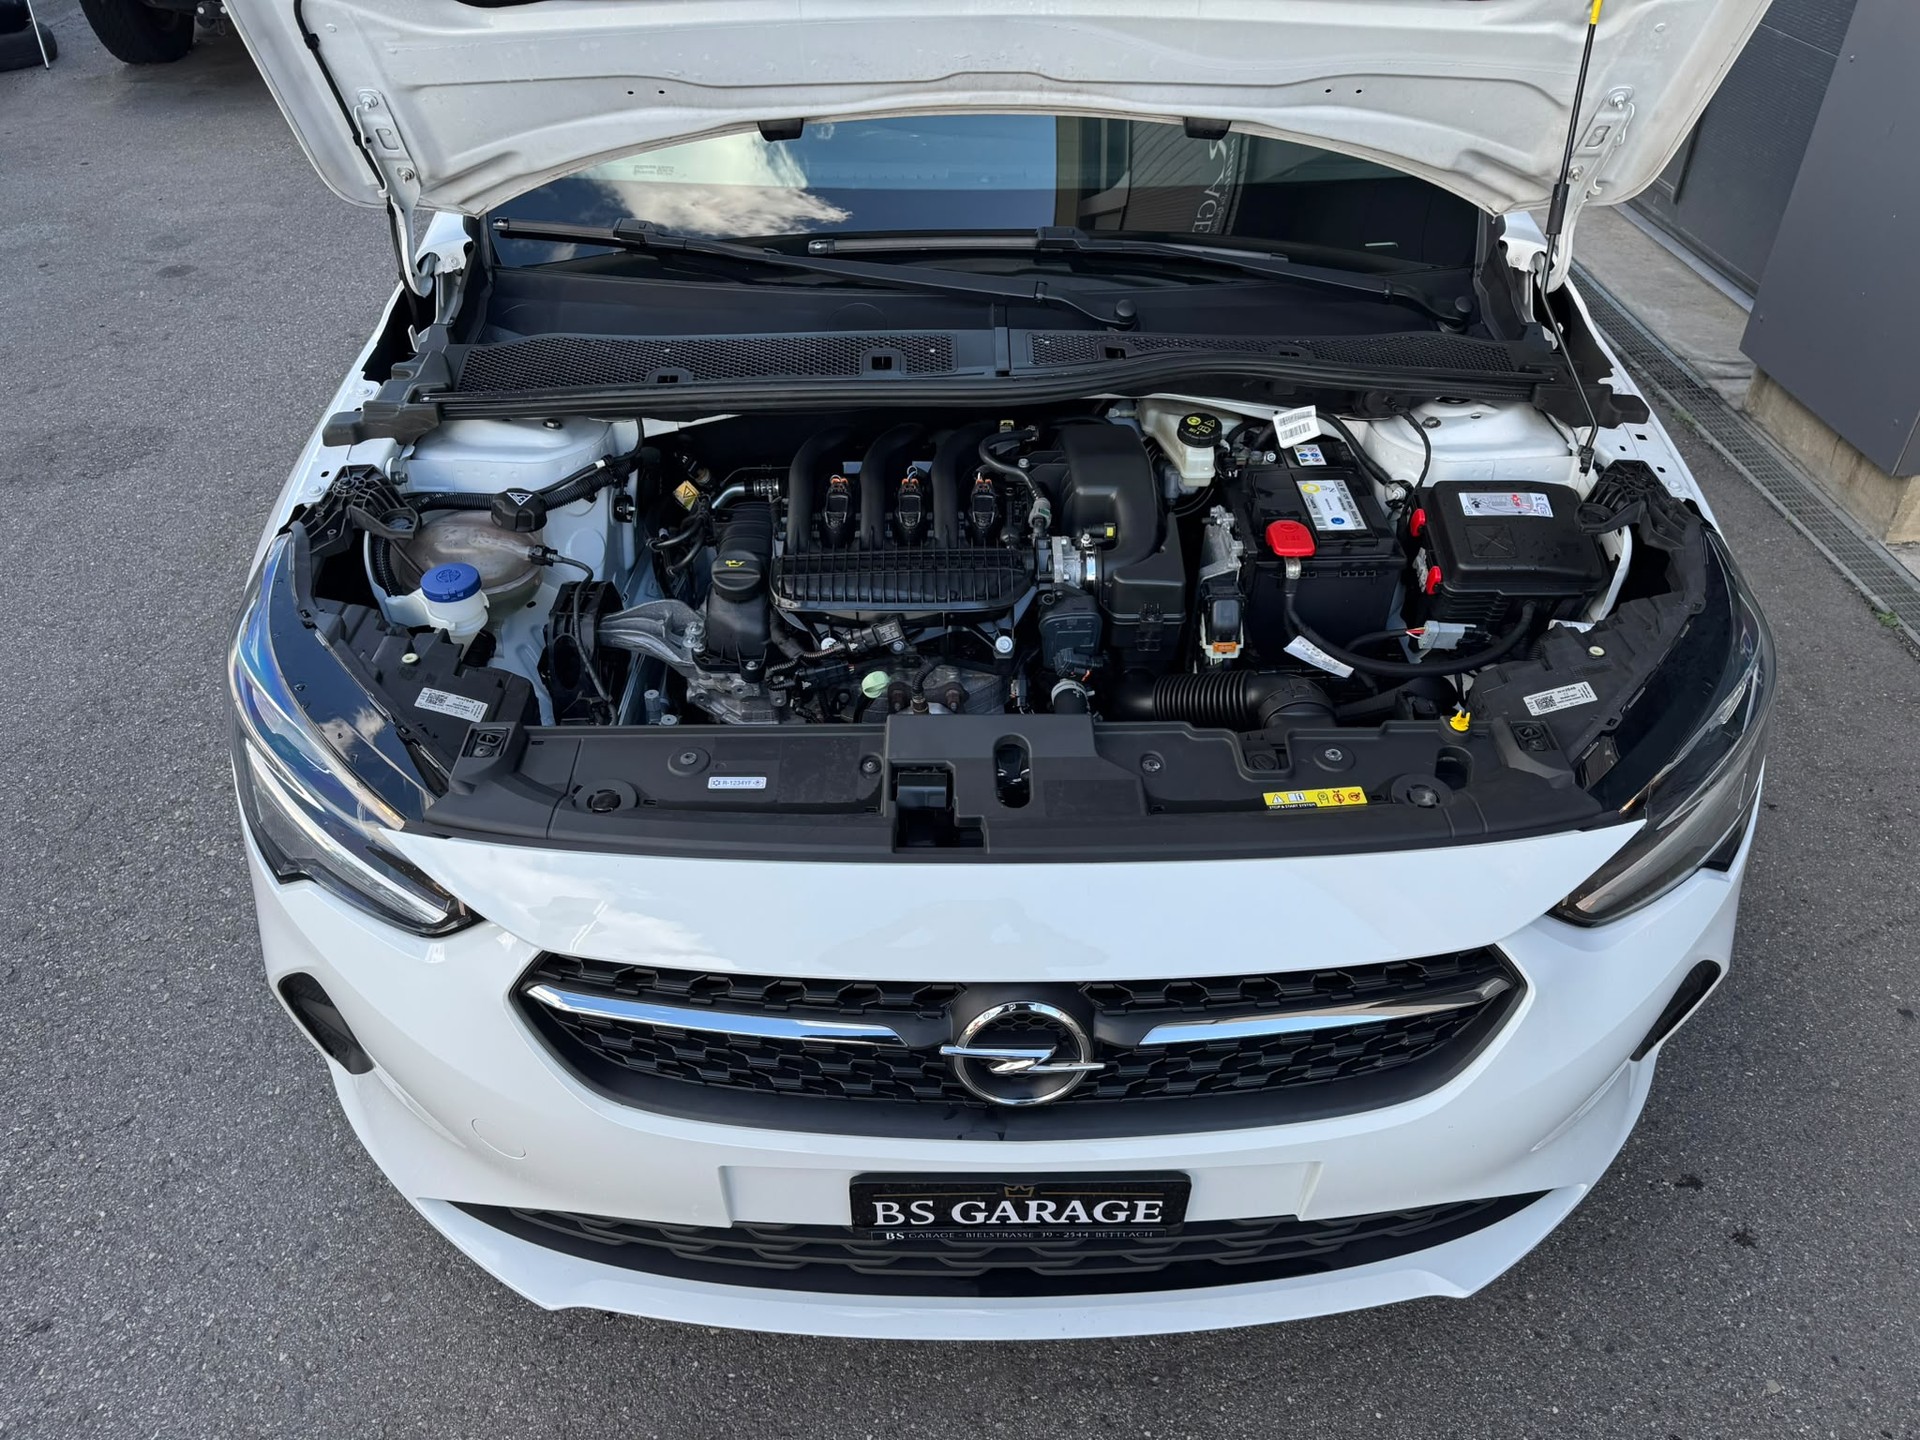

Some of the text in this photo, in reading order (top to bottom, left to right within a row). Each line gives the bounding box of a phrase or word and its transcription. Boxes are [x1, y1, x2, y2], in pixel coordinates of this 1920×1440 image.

[872, 1200, 1163, 1226] BS GARAGE
[885, 1231, 905, 1240] BS
